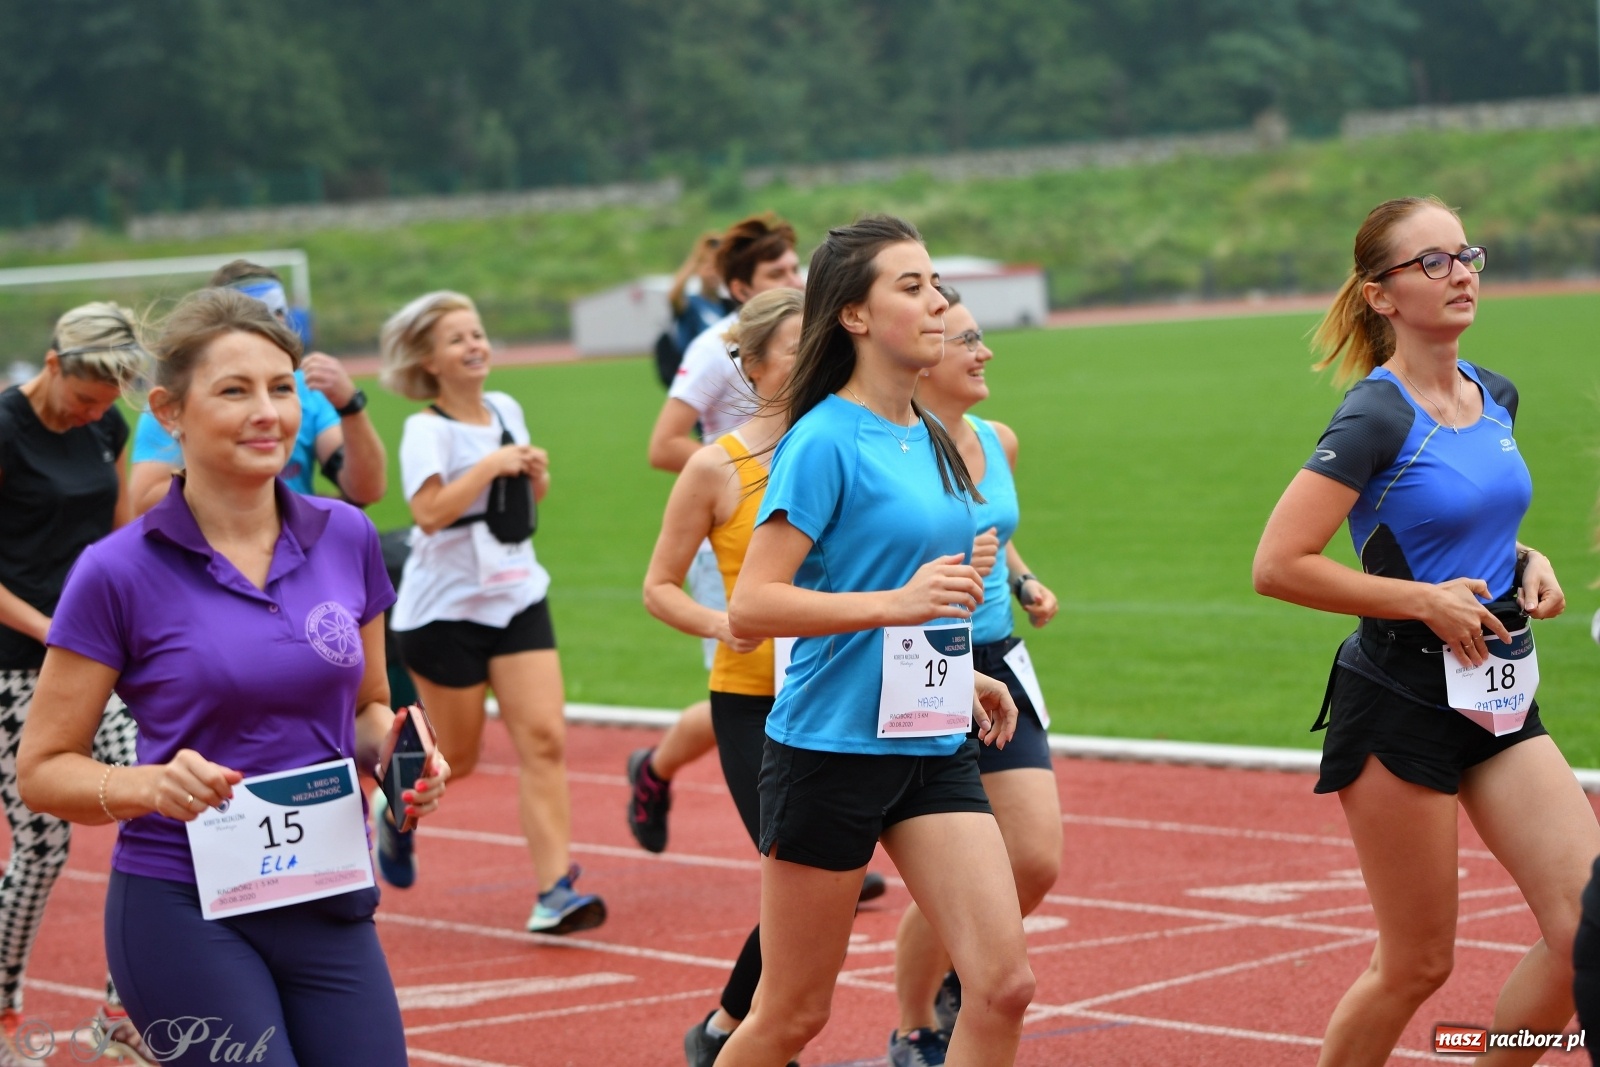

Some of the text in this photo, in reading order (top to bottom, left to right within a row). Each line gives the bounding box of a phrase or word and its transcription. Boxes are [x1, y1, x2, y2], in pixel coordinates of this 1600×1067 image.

[924, 658, 948, 687] 19
[1485, 663, 1516, 693] 18
[1474, 692, 1525, 711] PATRYCJA
[314, 778, 330, 788] BIEG
[330, 776, 340, 785] PO
[258, 810, 304, 849] 15
[260, 855, 298, 876] ELA
